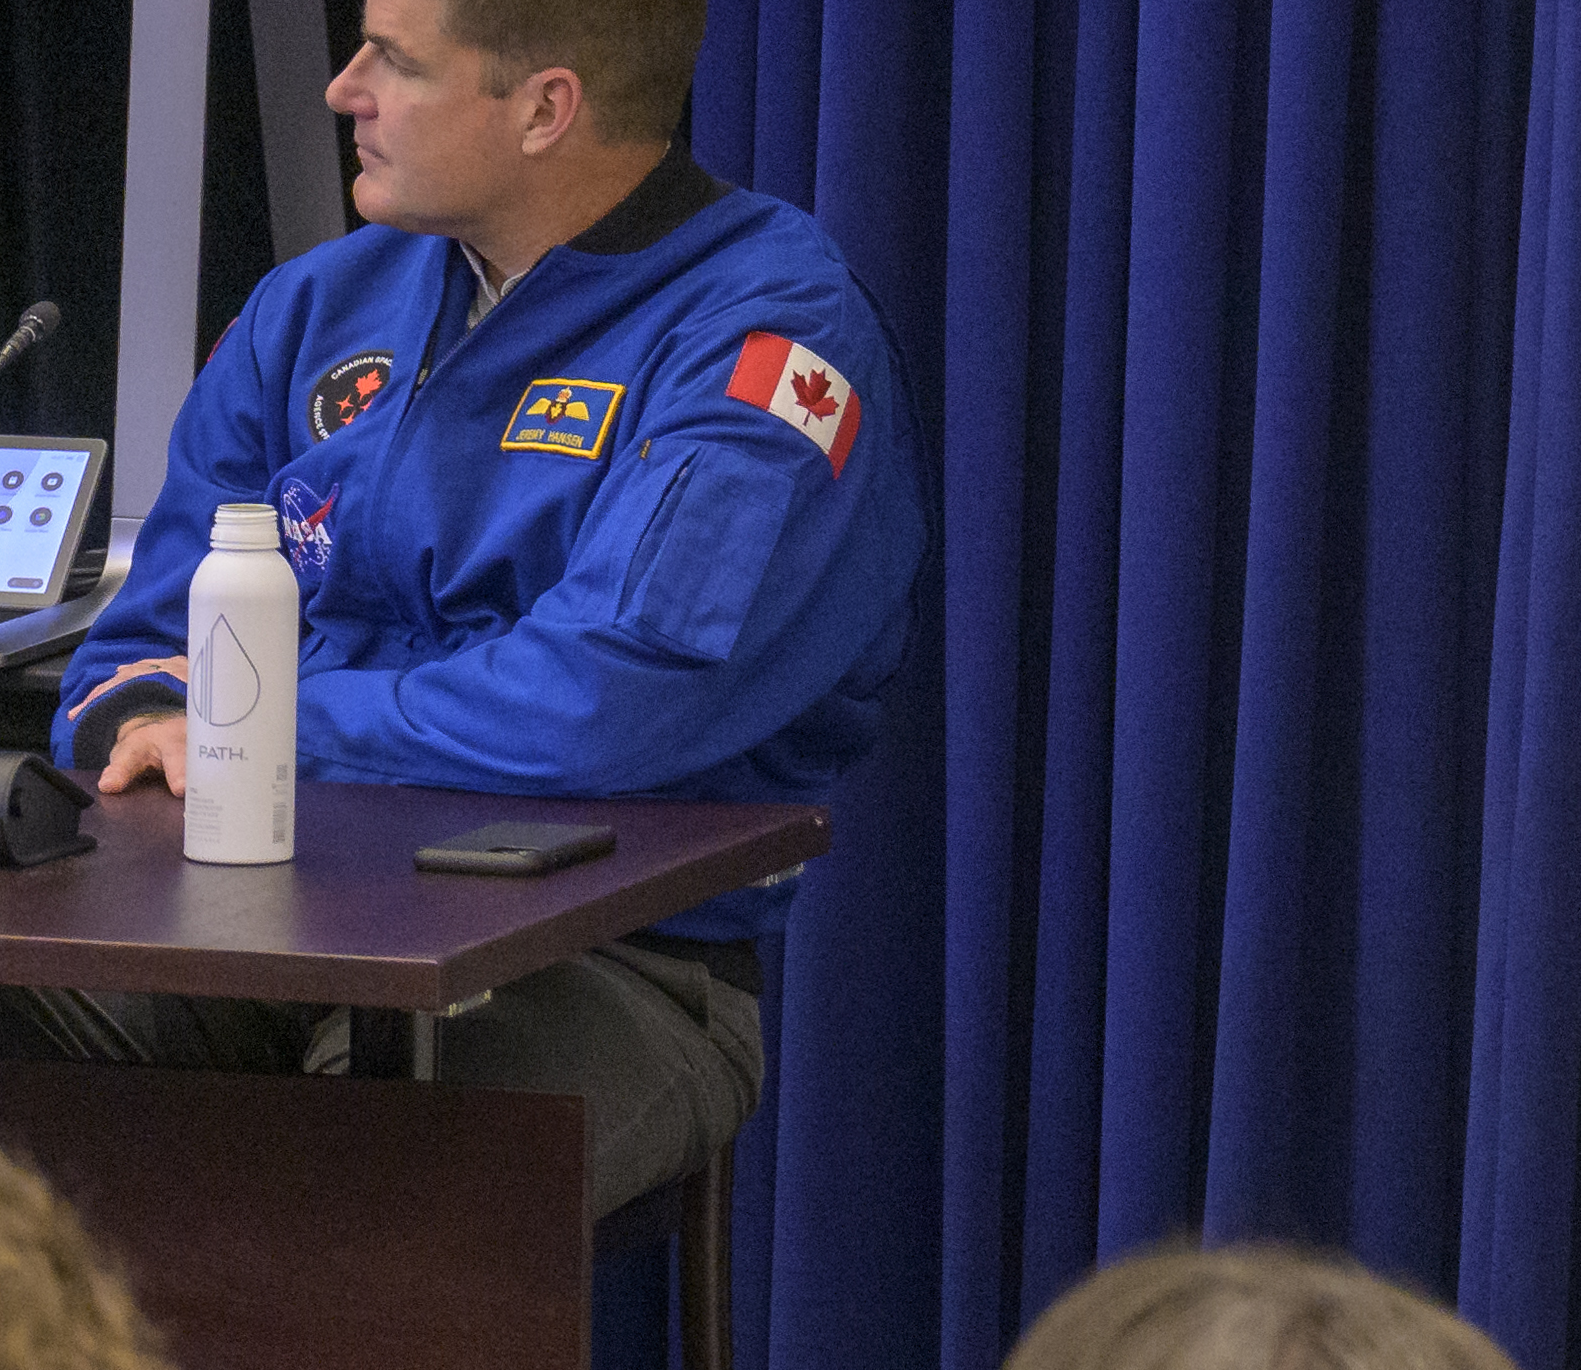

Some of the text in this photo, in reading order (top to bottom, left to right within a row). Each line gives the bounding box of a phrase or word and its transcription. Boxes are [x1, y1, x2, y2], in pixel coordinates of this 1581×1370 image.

[331, 356, 374, 380] CANADIAN
[313, 394, 324, 430] AGENCE
[547, 431, 584, 448] HANSEN
[282, 515, 333, 545] NASA
